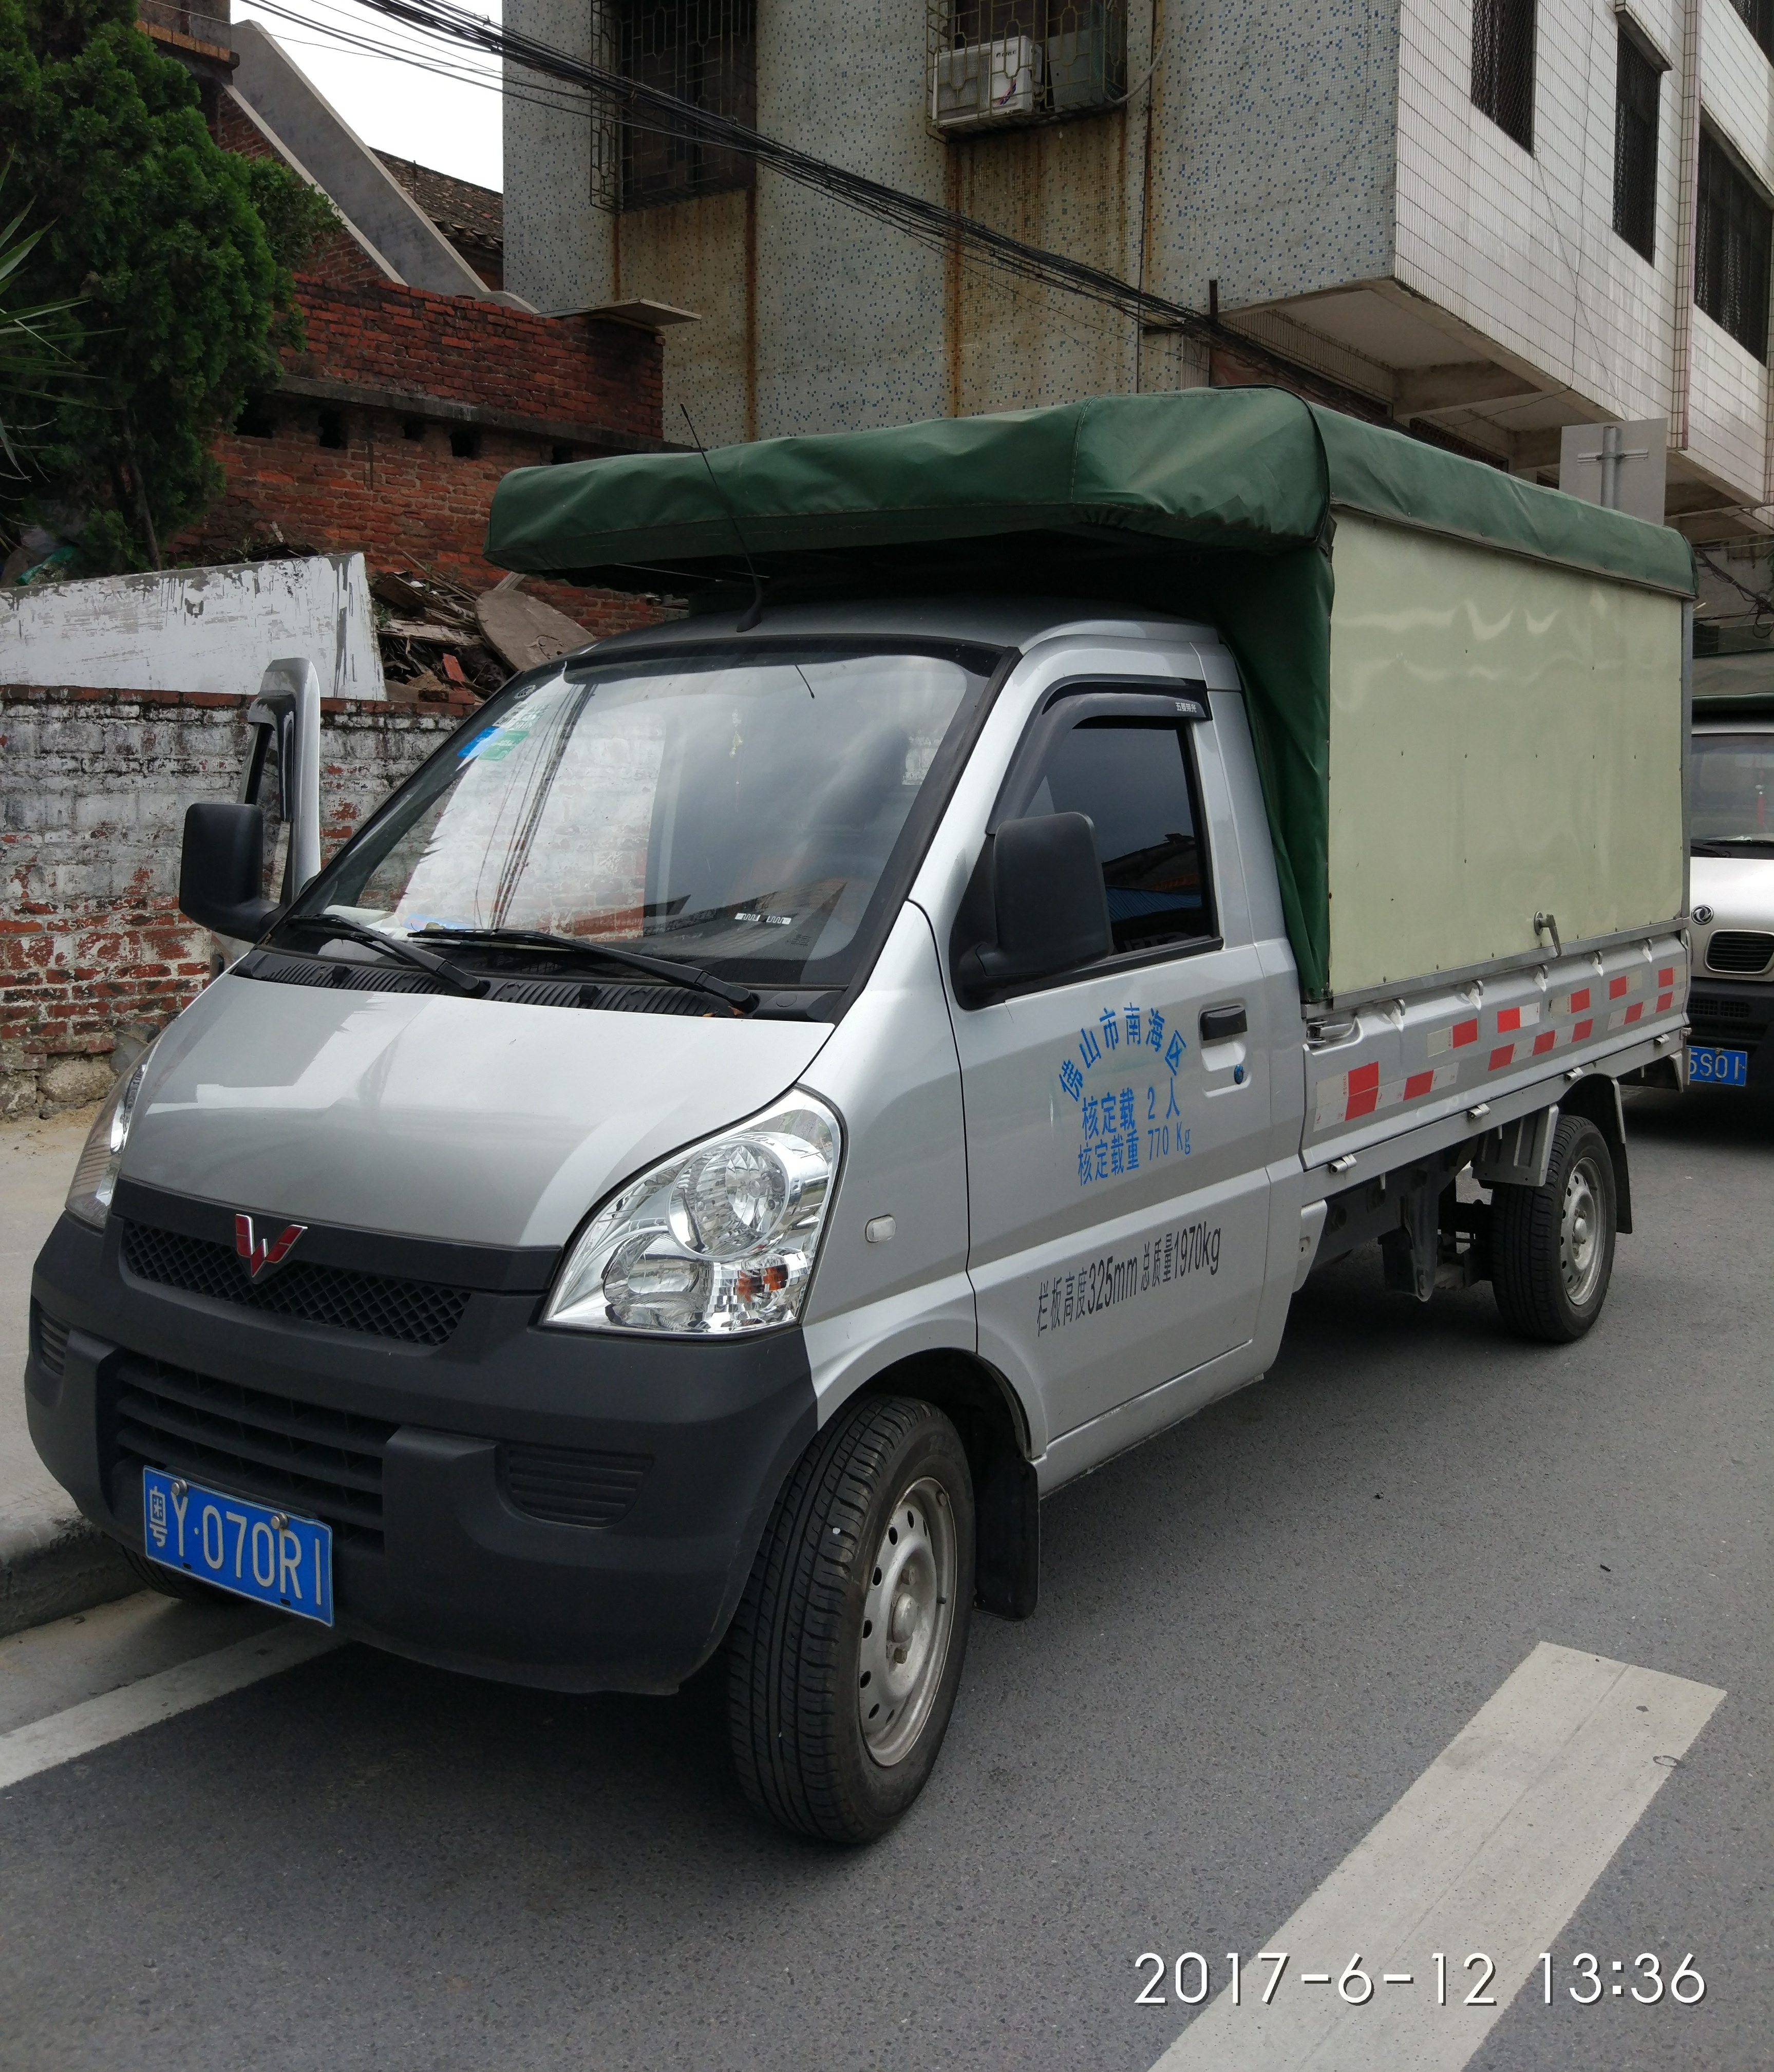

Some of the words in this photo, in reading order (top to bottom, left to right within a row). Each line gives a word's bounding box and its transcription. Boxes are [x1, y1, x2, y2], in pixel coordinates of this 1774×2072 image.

[1059, 1003, 1186, 1102] 佛山市南海区
[1082, 1087, 1135, 1141] 核定载
[1147, 1086, 1156, 1120] 2
[1166, 1077, 1180, 1120] 人
[1078, 1128, 1140, 1186] 核定载重
[1147, 1124, 1169, 1161] 770
[1141, 1221, 1221, 1291] 总质量1970kg
